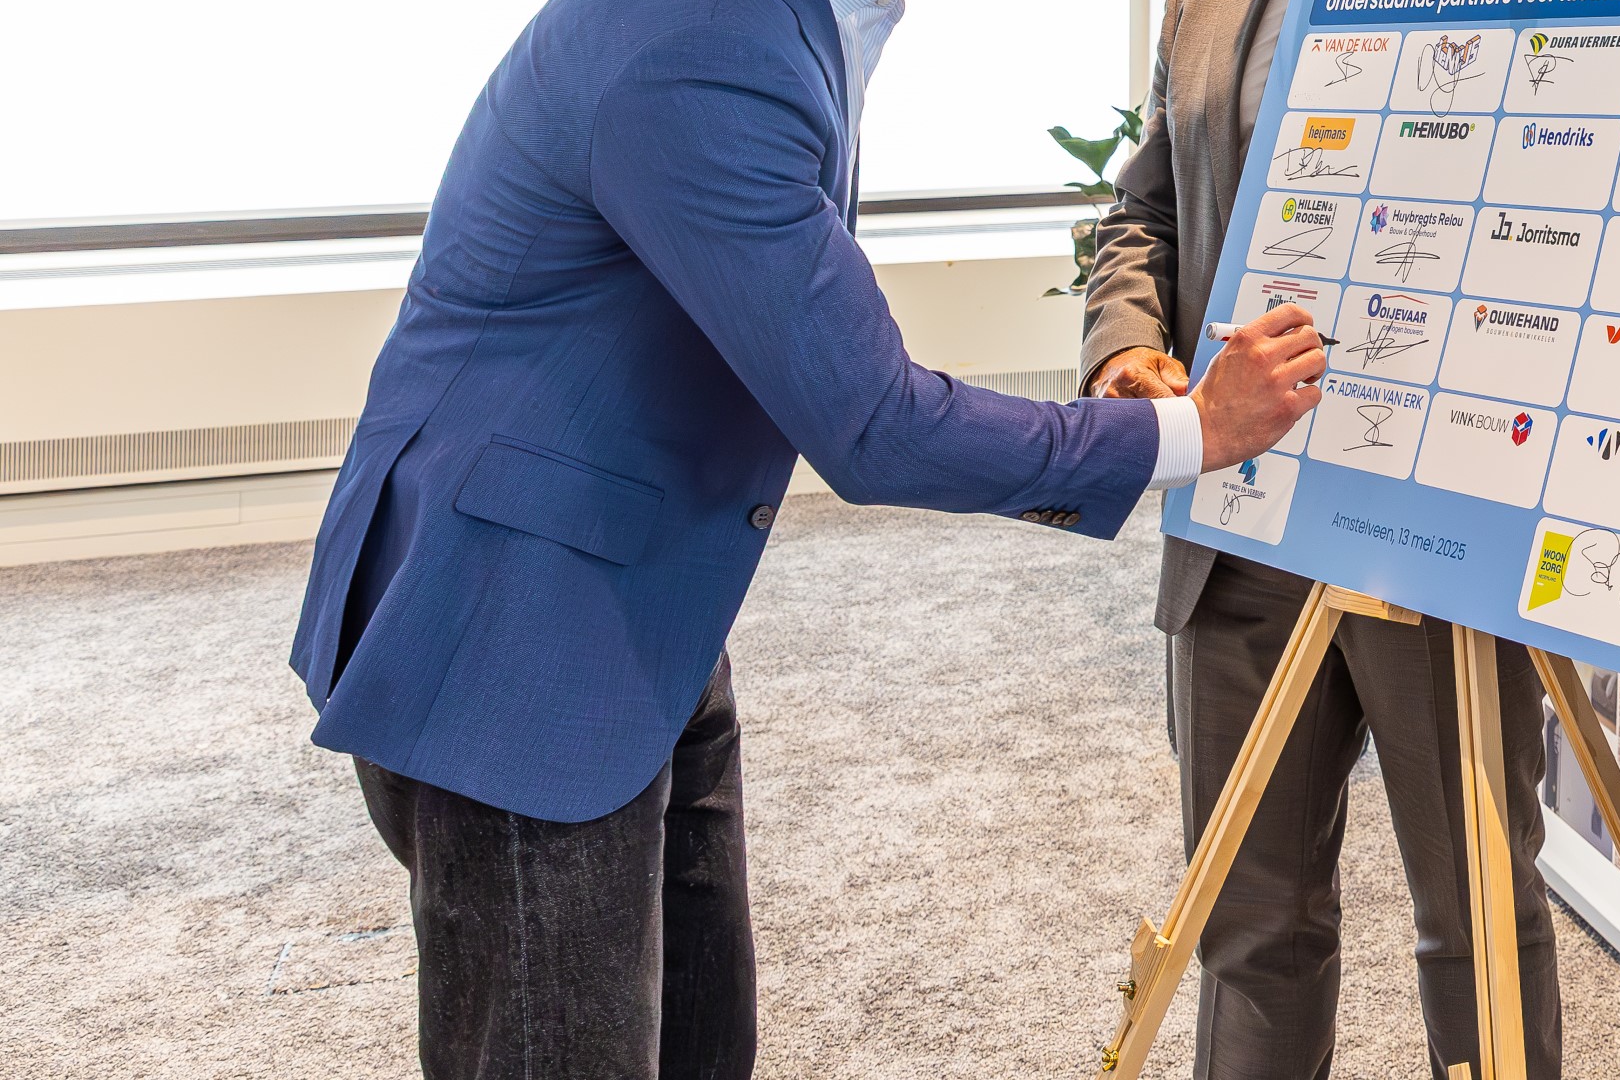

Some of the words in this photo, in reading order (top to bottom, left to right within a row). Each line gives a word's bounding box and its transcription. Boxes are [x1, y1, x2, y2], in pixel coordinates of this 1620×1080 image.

[1325, 38, 1347, 53] VAN
[1347, 38, 1360, 52] DE
[1361, 37, 1390, 52] KLOK
[1308, 125, 1347, 143] heijmans
[1412, 121, 1470, 140] HEMUBO
[1537, 127, 1594, 147] Hendriks
[1297, 199, 1328, 211] HILLEN
[1328, 202, 1333, 211] &
[1295, 212, 1331, 225] ROOSEN
[1392, 209, 1437, 227] Huybregts
[1438, 213, 1464, 227] Relou
[1389, 226, 1404, 235] Bouw
[1516, 223, 1580, 247] Jorritsma
[1489, 310, 1559, 332] OUWEHAND
[1337, 381, 1381, 402] ADRIAAN
[1383, 388, 1403, 406] VAN
[1403, 393, 1424, 410] ERK
[1331, 511, 1395, 545] Amstelveen,
[1398, 527, 1410, 546] 13
[1410, 534, 1436, 553] mei
[1435, 537, 1467, 561] 2025
[1543, 549, 1566, 562] WOON
[1541, 560, 1561, 574] ZORG
